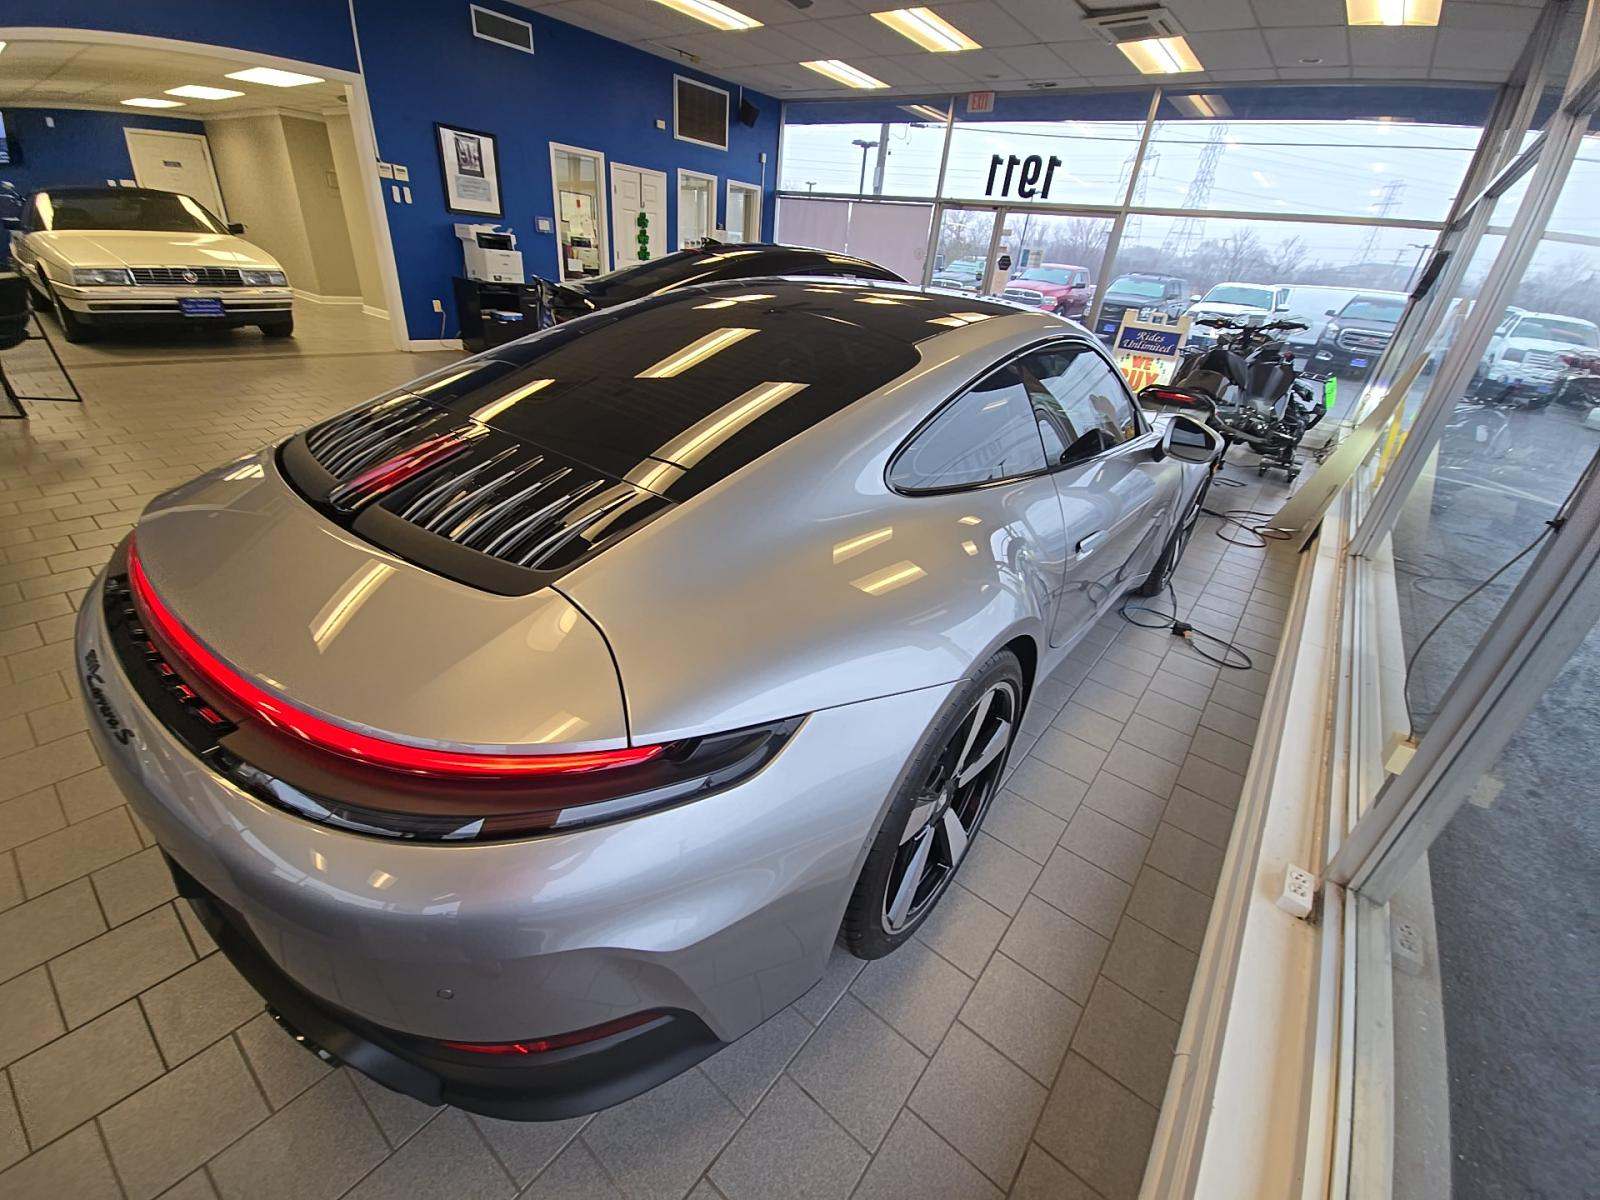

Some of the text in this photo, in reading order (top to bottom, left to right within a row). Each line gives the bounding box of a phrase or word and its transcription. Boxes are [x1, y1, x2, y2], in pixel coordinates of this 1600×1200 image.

[971, 93, 991, 110] EXIT
[1135, 331, 1166, 343] Rides
[1122, 338, 1175, 353] Unlimited
[1132, 355, 1154, 371] WE
[114, 729, 135, 745] S
